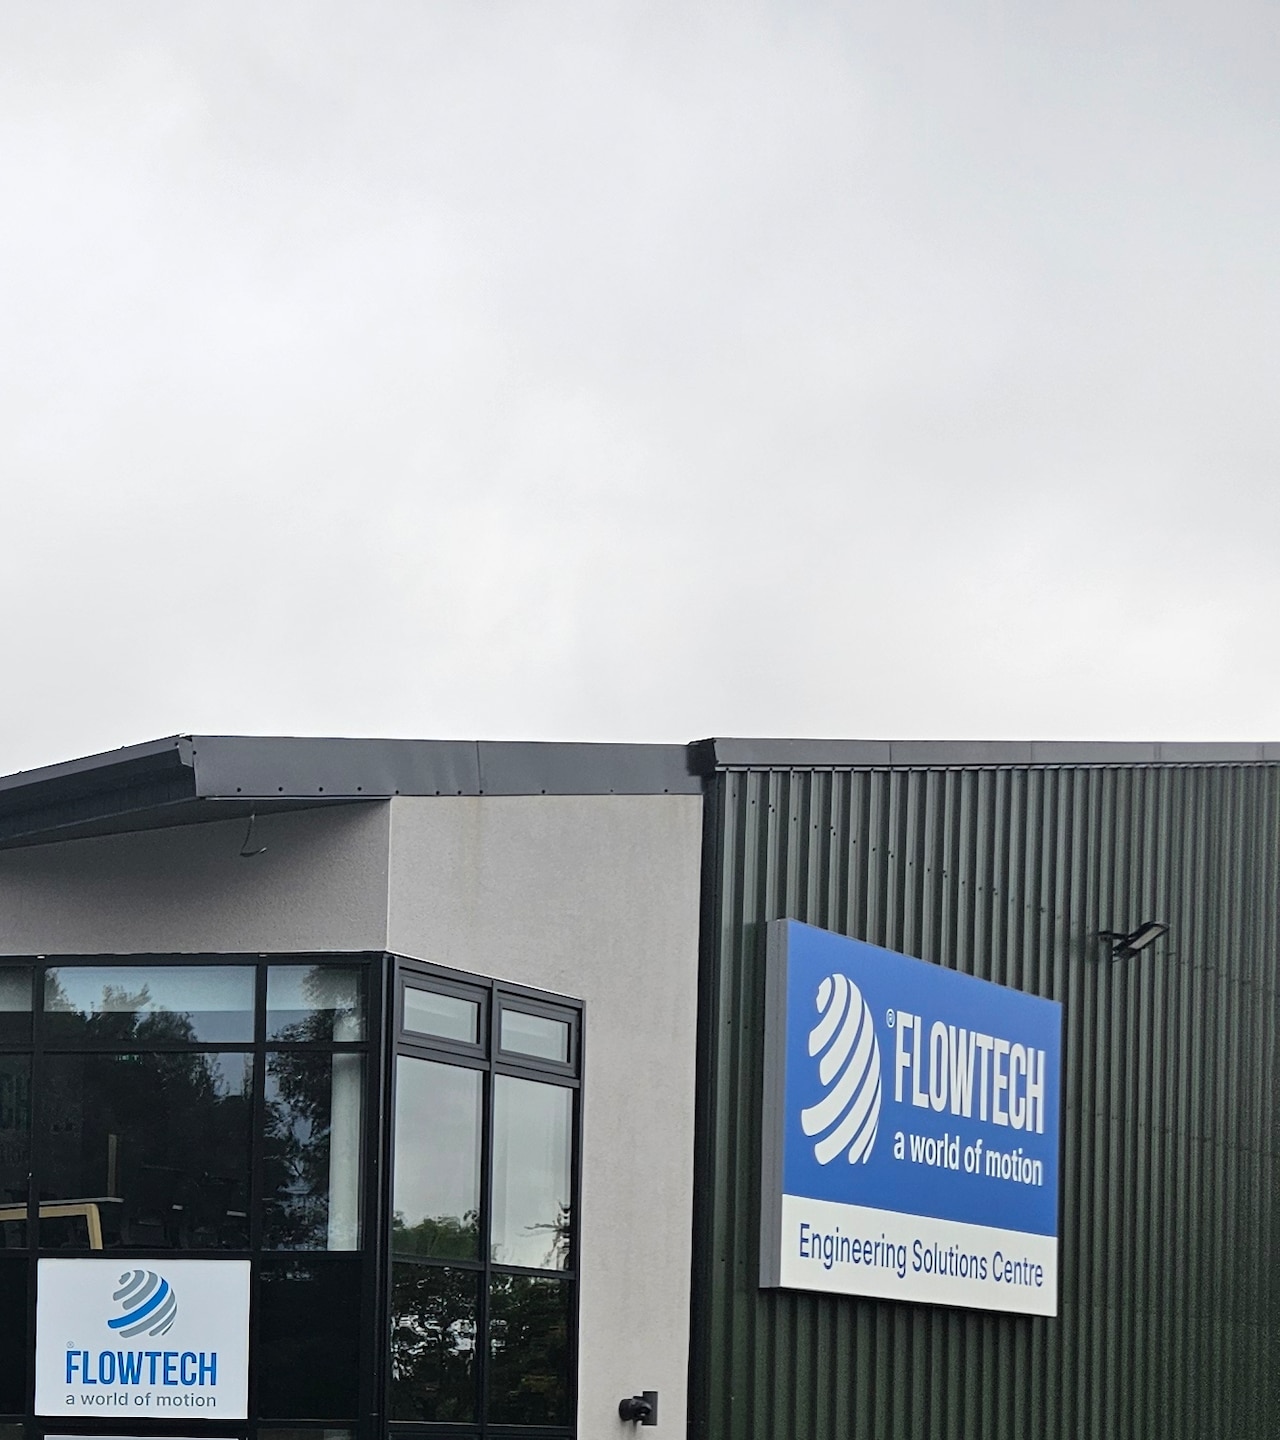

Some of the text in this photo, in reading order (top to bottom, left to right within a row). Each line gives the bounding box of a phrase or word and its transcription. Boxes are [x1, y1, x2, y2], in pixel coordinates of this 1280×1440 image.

[895, 1010, 1046, 1134] FLOWTECH
[893, 1131, 1044, 1187] a world of motion
[799, 1223, 1044, 1288] Engineering Solutions Centre
[66, 1350, 217, 1386] FLOWTECH
[66, 1392, 217, 1407] a world of motion
